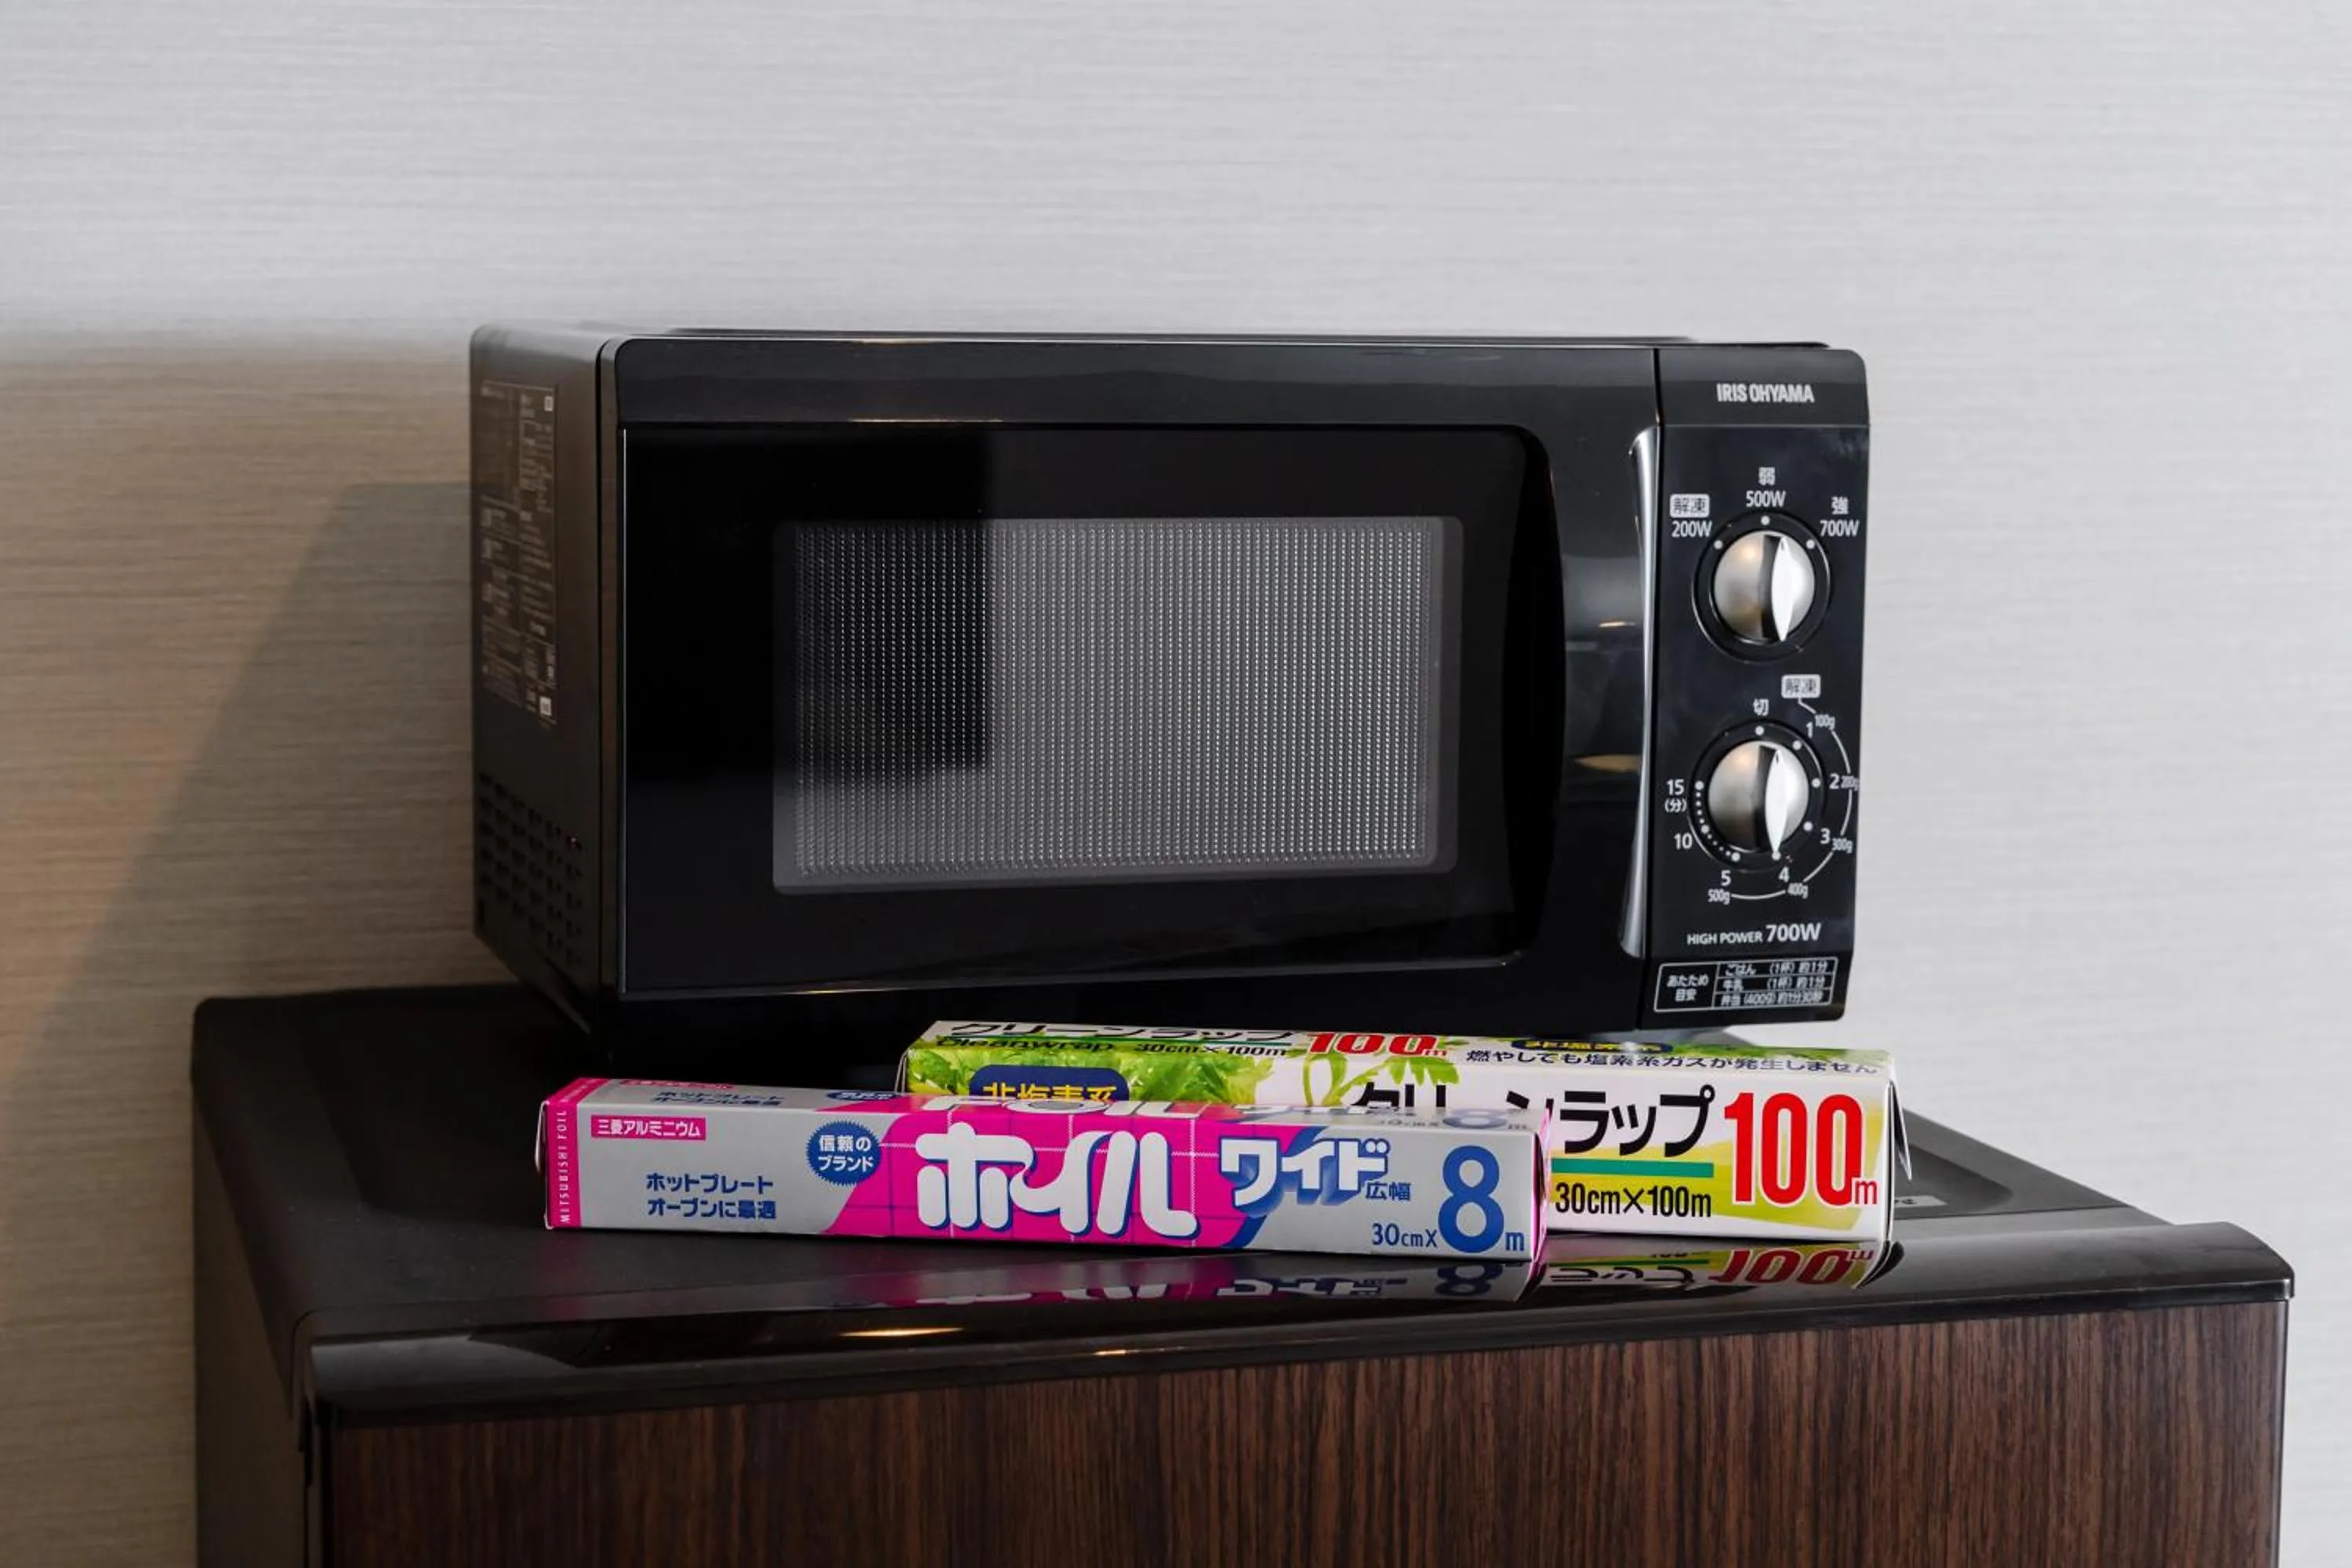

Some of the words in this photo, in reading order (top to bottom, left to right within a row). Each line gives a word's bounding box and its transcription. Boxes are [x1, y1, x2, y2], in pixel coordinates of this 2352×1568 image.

[1716, 383, 1748, 403] IRIS
[1749, 384, 1815, 404] OHYAMA
[1758, 466, 1776, 486] 弱
[1673, 497, 1708, 516] 解凍
[1745, 489, 1787, 508] 500W
[1831, 496, 1849, 515] 強
[1671, 520, 1713, 539] 200W
[1820, 519, 1860, 538] 700W
[1753, 698, 1769, 716] 切
[1806, 721, 1813, 739] 1
[1814, 713, 1835, 731] 100g
[1666, 779, 1686, 795] 15
[1829, 773, 1840, 789] 2
[1673, 833, 1693, 849] 10
[1820, 829, 1831, 844] 3
[1831, 838, 1853, 854] 300g
[1720, 870, 1732, 887] 5
[1778, 867, 1790, 882] 4
[1708, 888, 1731, 905] 500g
[1787, 883, 1809, 898] 400g
[1686, 932, 1718, 946] HIGH
[1719, 930, 1763, 944] POWER
[1765, 922, 1822, 942] 700W
[1666, 974, 1709, 988] あたため
[1674, 988, 1698, 1002] 目安
[951, 1022, 1293, 1042] クリーンラップ
[556, 1109, 568, 1140] FOIL
[597, 1118, 702, 1138] 三菱アルミニウム
[818, 1134, 873, 1153] 信頼の
[1723, 1091, 1879, 1207] 100m
[817, 1155, 874, 1174] ブランド
[645, 1172, 775, 1196] ホットプレート
[916, 1122, 1200, 1238] ホイル
[1220, 1138, 1391, 1211] ワイド
[557, 1145, 571, 1224] MITSUBISHI
[1365, 1181, 1411, 1202] 広幅
[647, 1197, 777, 1221] オーブンに最適
